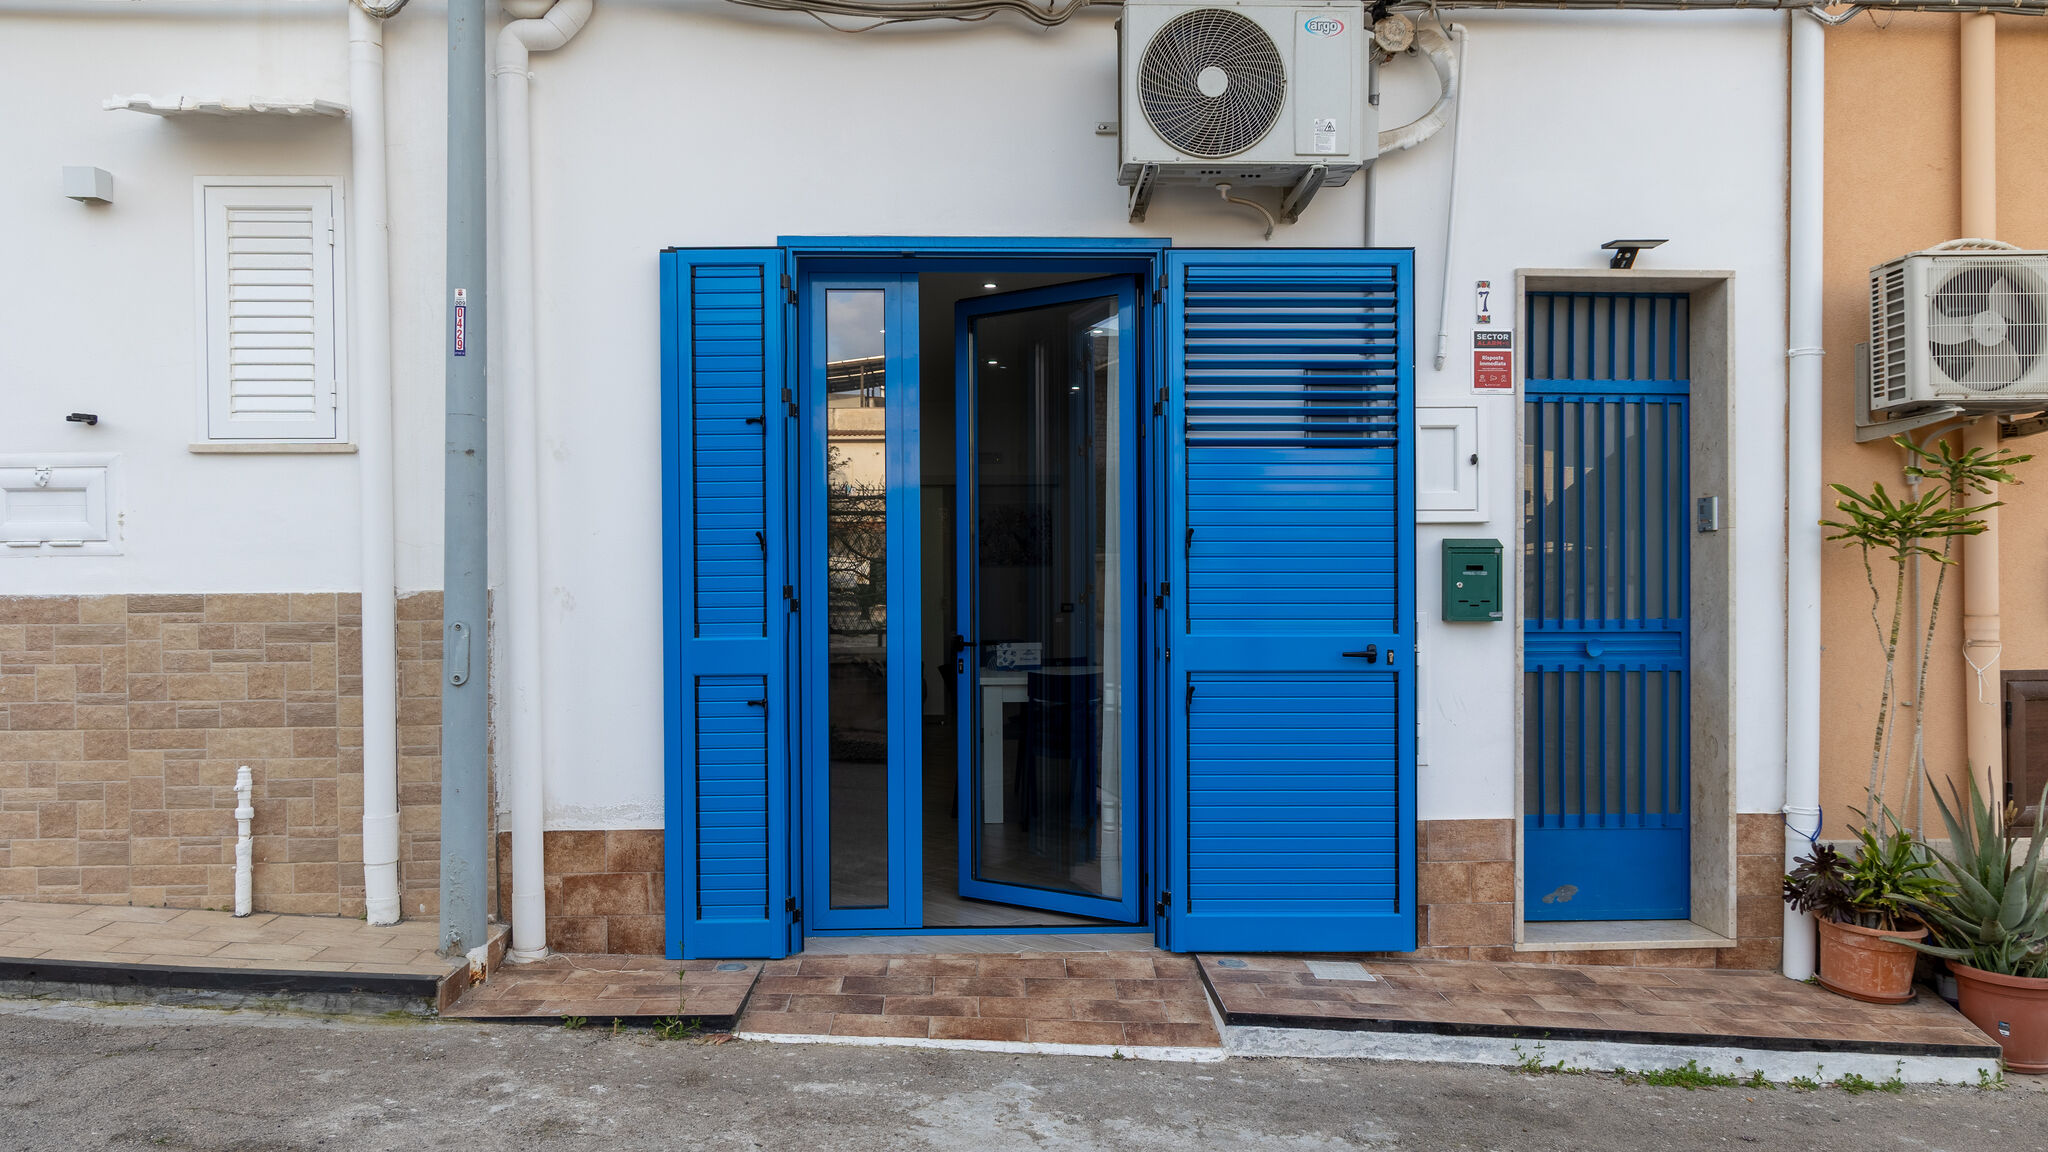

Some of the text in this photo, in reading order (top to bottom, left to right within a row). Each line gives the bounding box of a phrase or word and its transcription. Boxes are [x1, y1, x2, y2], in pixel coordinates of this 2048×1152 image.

[1309, 20, 1338, 35] argo
[1478, 291, 1490, 312] 7
[1476, 333, 1509, 341] SECTOR
